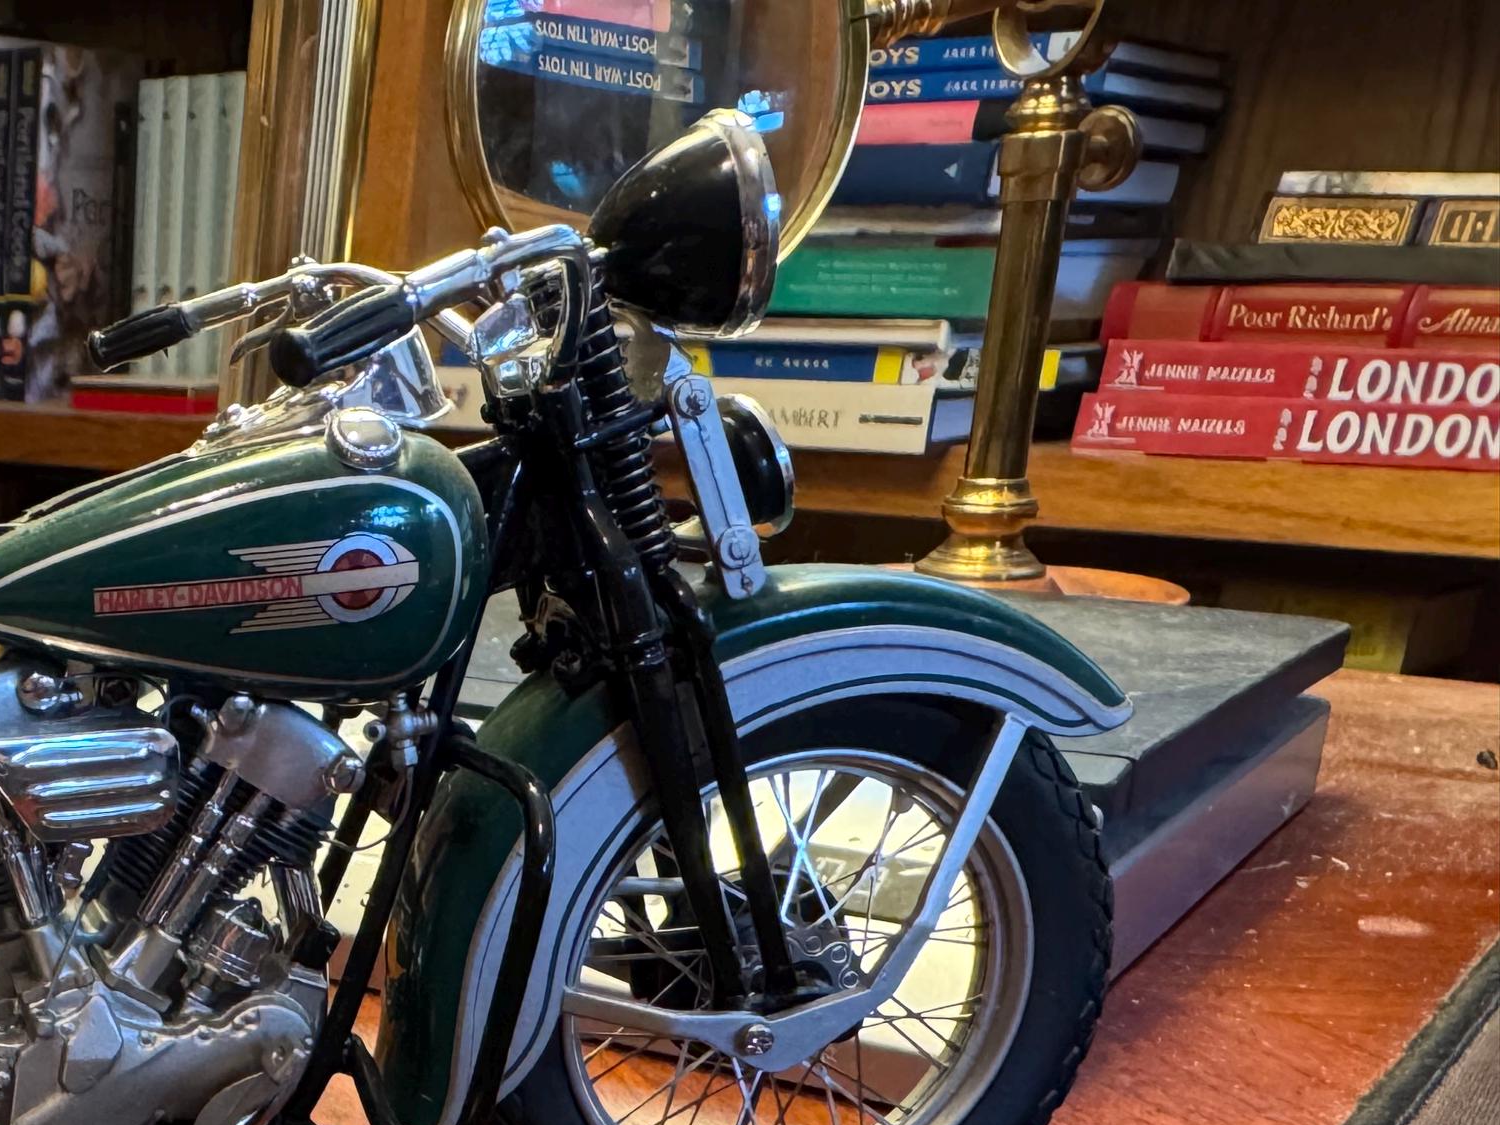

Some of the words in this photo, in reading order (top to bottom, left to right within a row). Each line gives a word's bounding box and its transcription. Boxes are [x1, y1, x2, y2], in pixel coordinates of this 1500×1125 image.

[535, 19, 565, 40] TOYS
[567, 24, 589, 45] TIN
[538, 53, 568, 75] TOYS
[868, 46, 920, 65] OYS
[570, 60, 593, 80] TIN
[866, 78, 922, 98] OYS
[1227, 303, 1283, 330] Poor
[1287, 304, 1393, 331] Richard's
[98, 575, 304, 613] HARLEY-DAVIDSON
